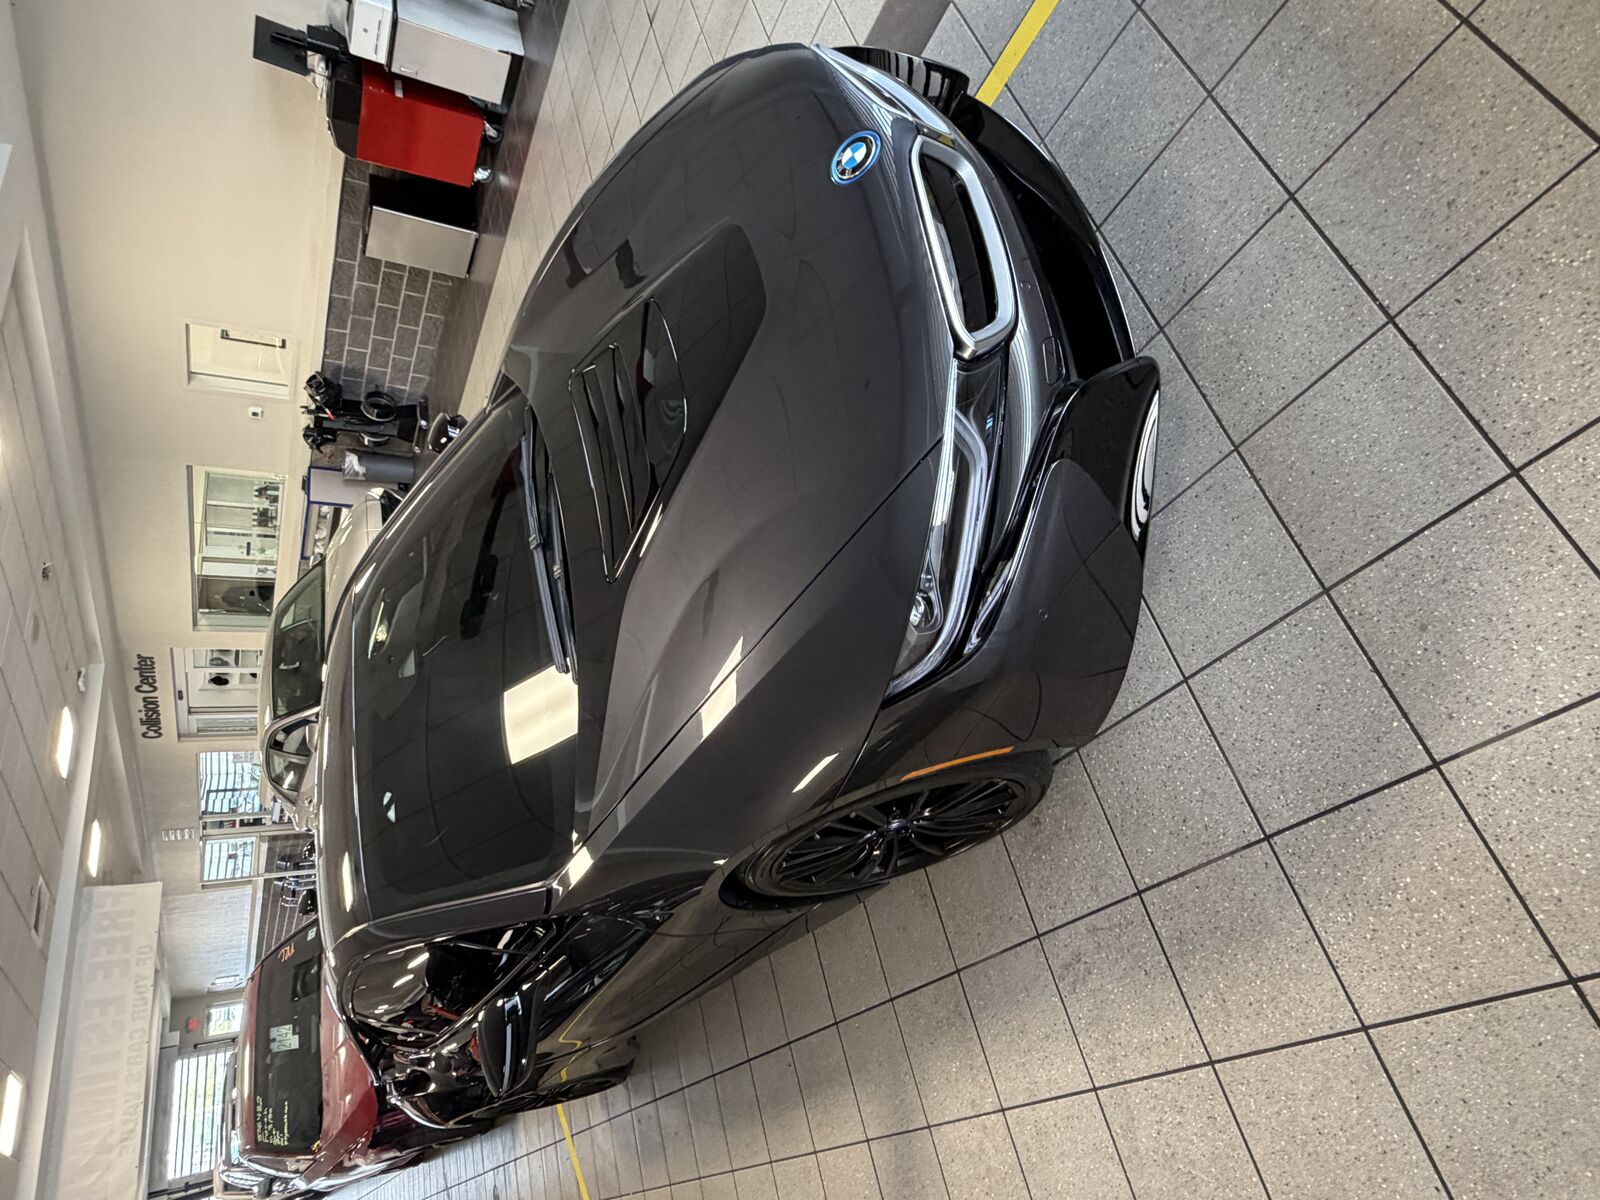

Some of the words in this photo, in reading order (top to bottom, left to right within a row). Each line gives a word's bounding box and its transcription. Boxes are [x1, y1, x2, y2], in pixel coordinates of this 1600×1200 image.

[133, 654, 158, 694] Center
[138, 696, 163, 739] Collision
[276, 1026, 291, 1050] 2142
